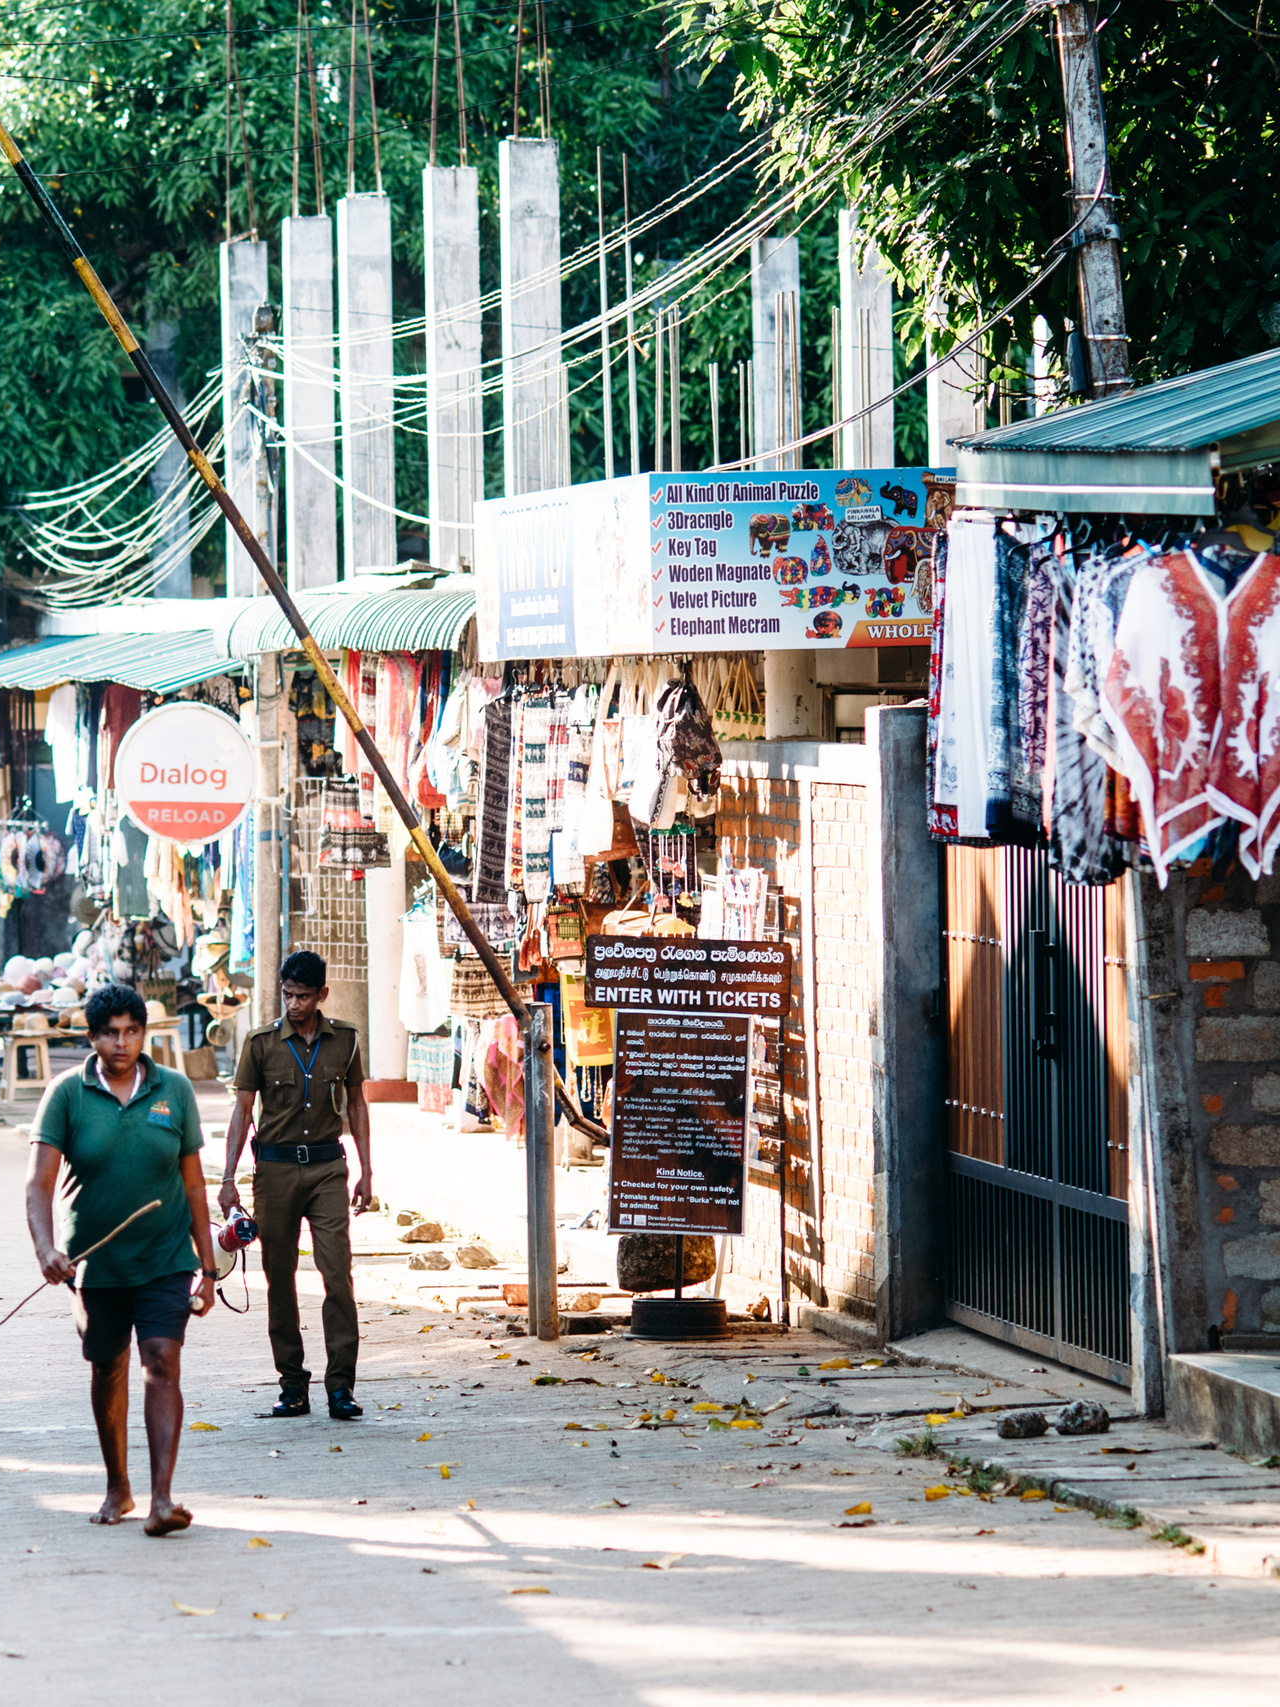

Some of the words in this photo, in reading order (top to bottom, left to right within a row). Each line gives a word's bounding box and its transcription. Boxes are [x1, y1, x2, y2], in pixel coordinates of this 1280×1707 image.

[666, 485, 683, 504] All
[686, 483, 715, 503] Kind
[717, 484, 730, 502] Of
[732, 482, 776, 502] Animal
[778, 481, 819, 501] Puzzle
[667, 510, 733, 531] 3Dracngle
[668, 539, 691, 558] Key
[693, 537, 717, 557] Tag
[669, 563, 713, 582] Woden
[715, 563, 772, 583] Magnate
[670, 590, 710, 609] Velvet
[713, 589, 757, 608] Picture
[670, 616, 725, 638] Elephant
[729, 616, 780, 635] Mecram
[867, 623, 933, 640] WHOLE
[140, 762, 227, 790] Dialog
[148, 809, 225, 823] RELOAD
[595, 987, 652, 1003] ENTER
[657, 989, 701, 1005] WITH
[706, 991, 781, 1008] TICKETS
[657, 1168, 674, 1176] Kind
[677, 1169, 704, 1178] Notice.
[650, 1194, 675, 1202] dressed
[710, 1186, 735, 1194] safety.
